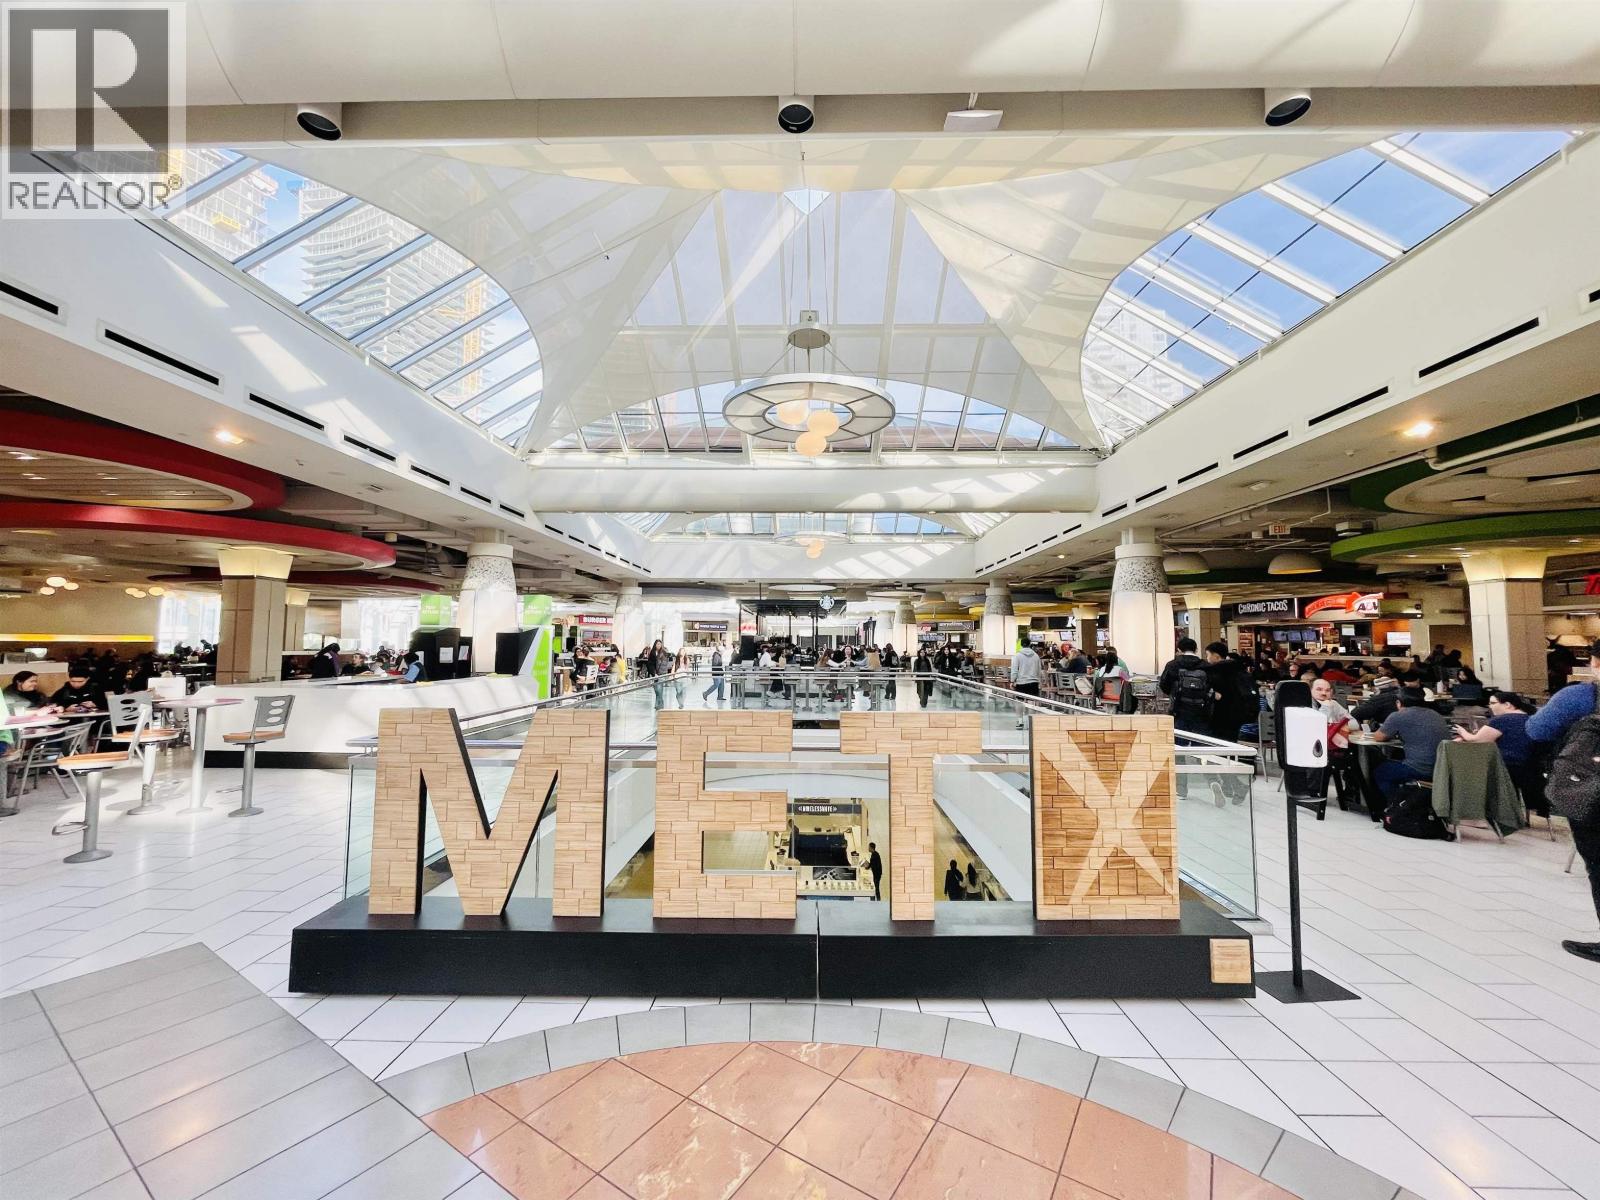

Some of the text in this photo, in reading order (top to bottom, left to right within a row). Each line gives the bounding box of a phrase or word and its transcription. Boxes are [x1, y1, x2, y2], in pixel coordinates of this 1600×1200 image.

[1238, 600, 1288, 614] CHRONIC TACOS
[583, 616, 606, 624] BURGER
